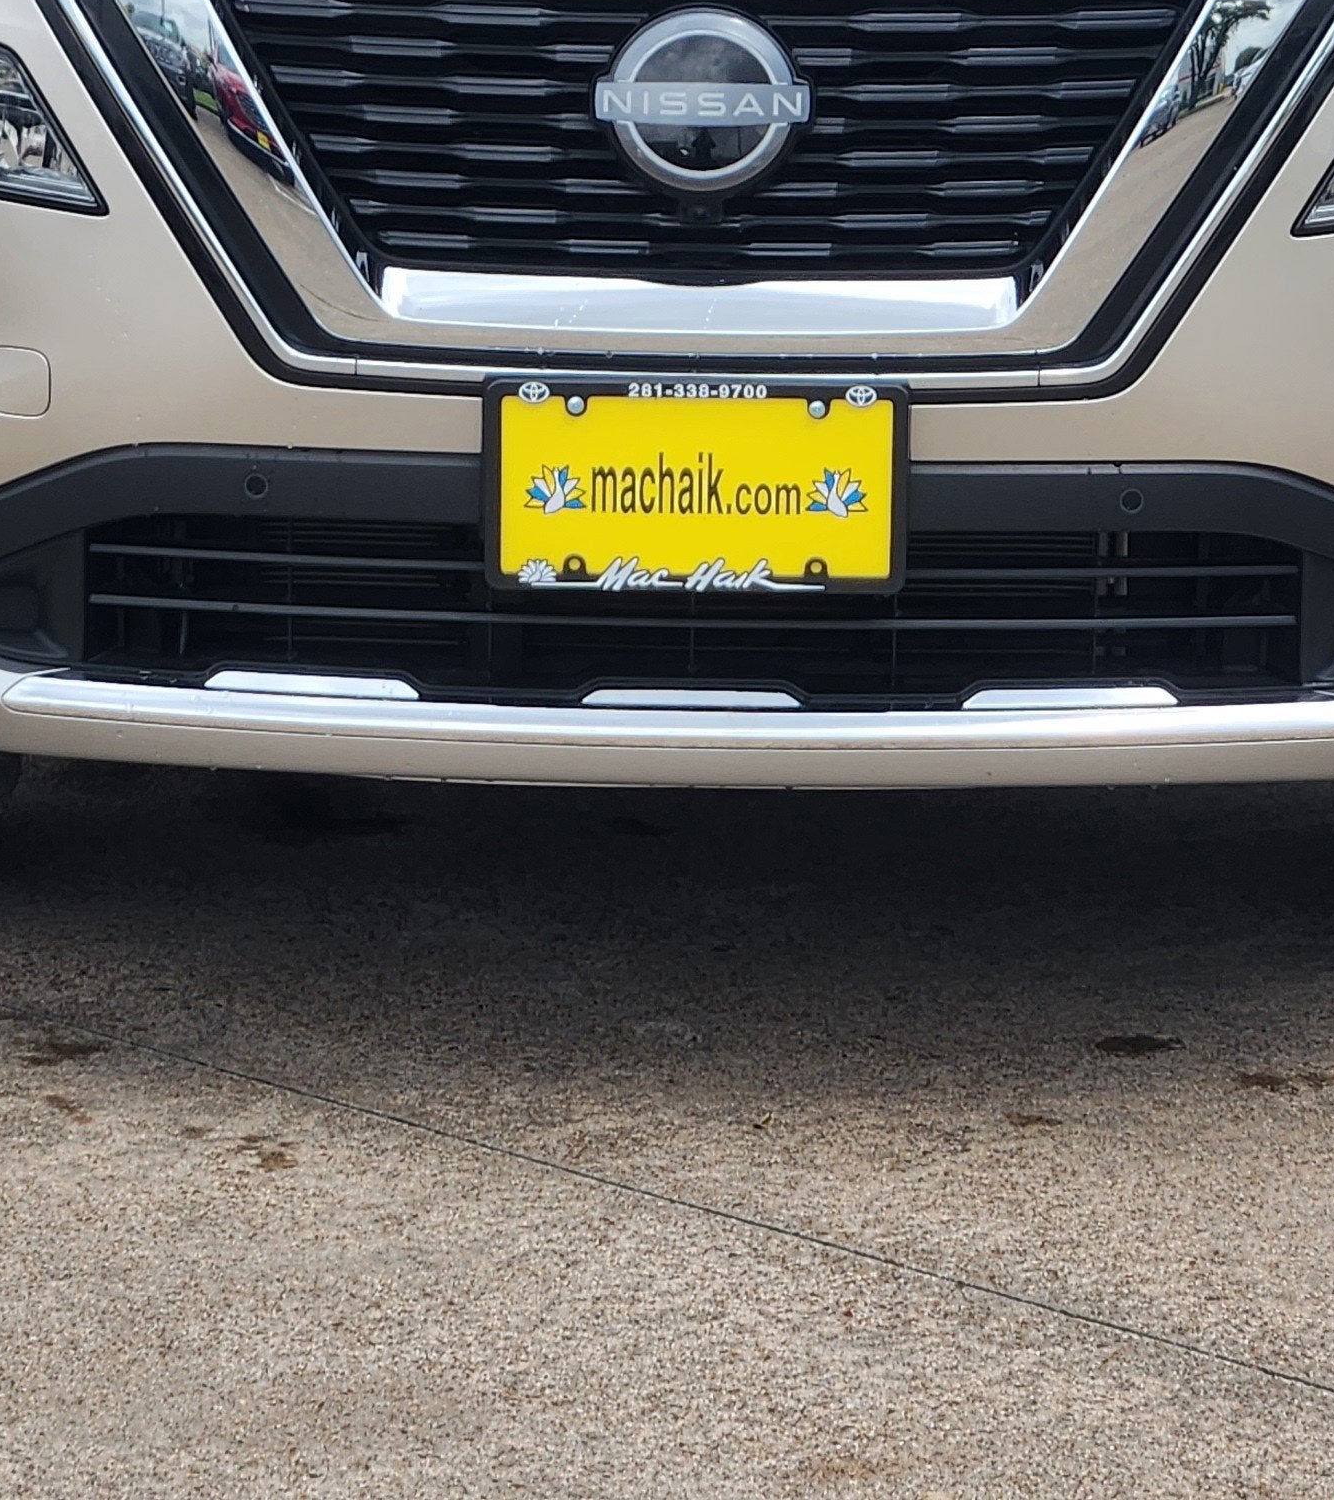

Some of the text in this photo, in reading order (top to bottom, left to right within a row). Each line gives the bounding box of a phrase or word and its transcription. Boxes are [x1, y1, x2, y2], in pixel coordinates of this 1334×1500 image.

[602, 89, 802, 117] NISSAN
[627, 382, 768, 399] 281-338-9700
[591, 452, 802, 515] machaik.com
[597, 556, 773, 592] Mac Haik
